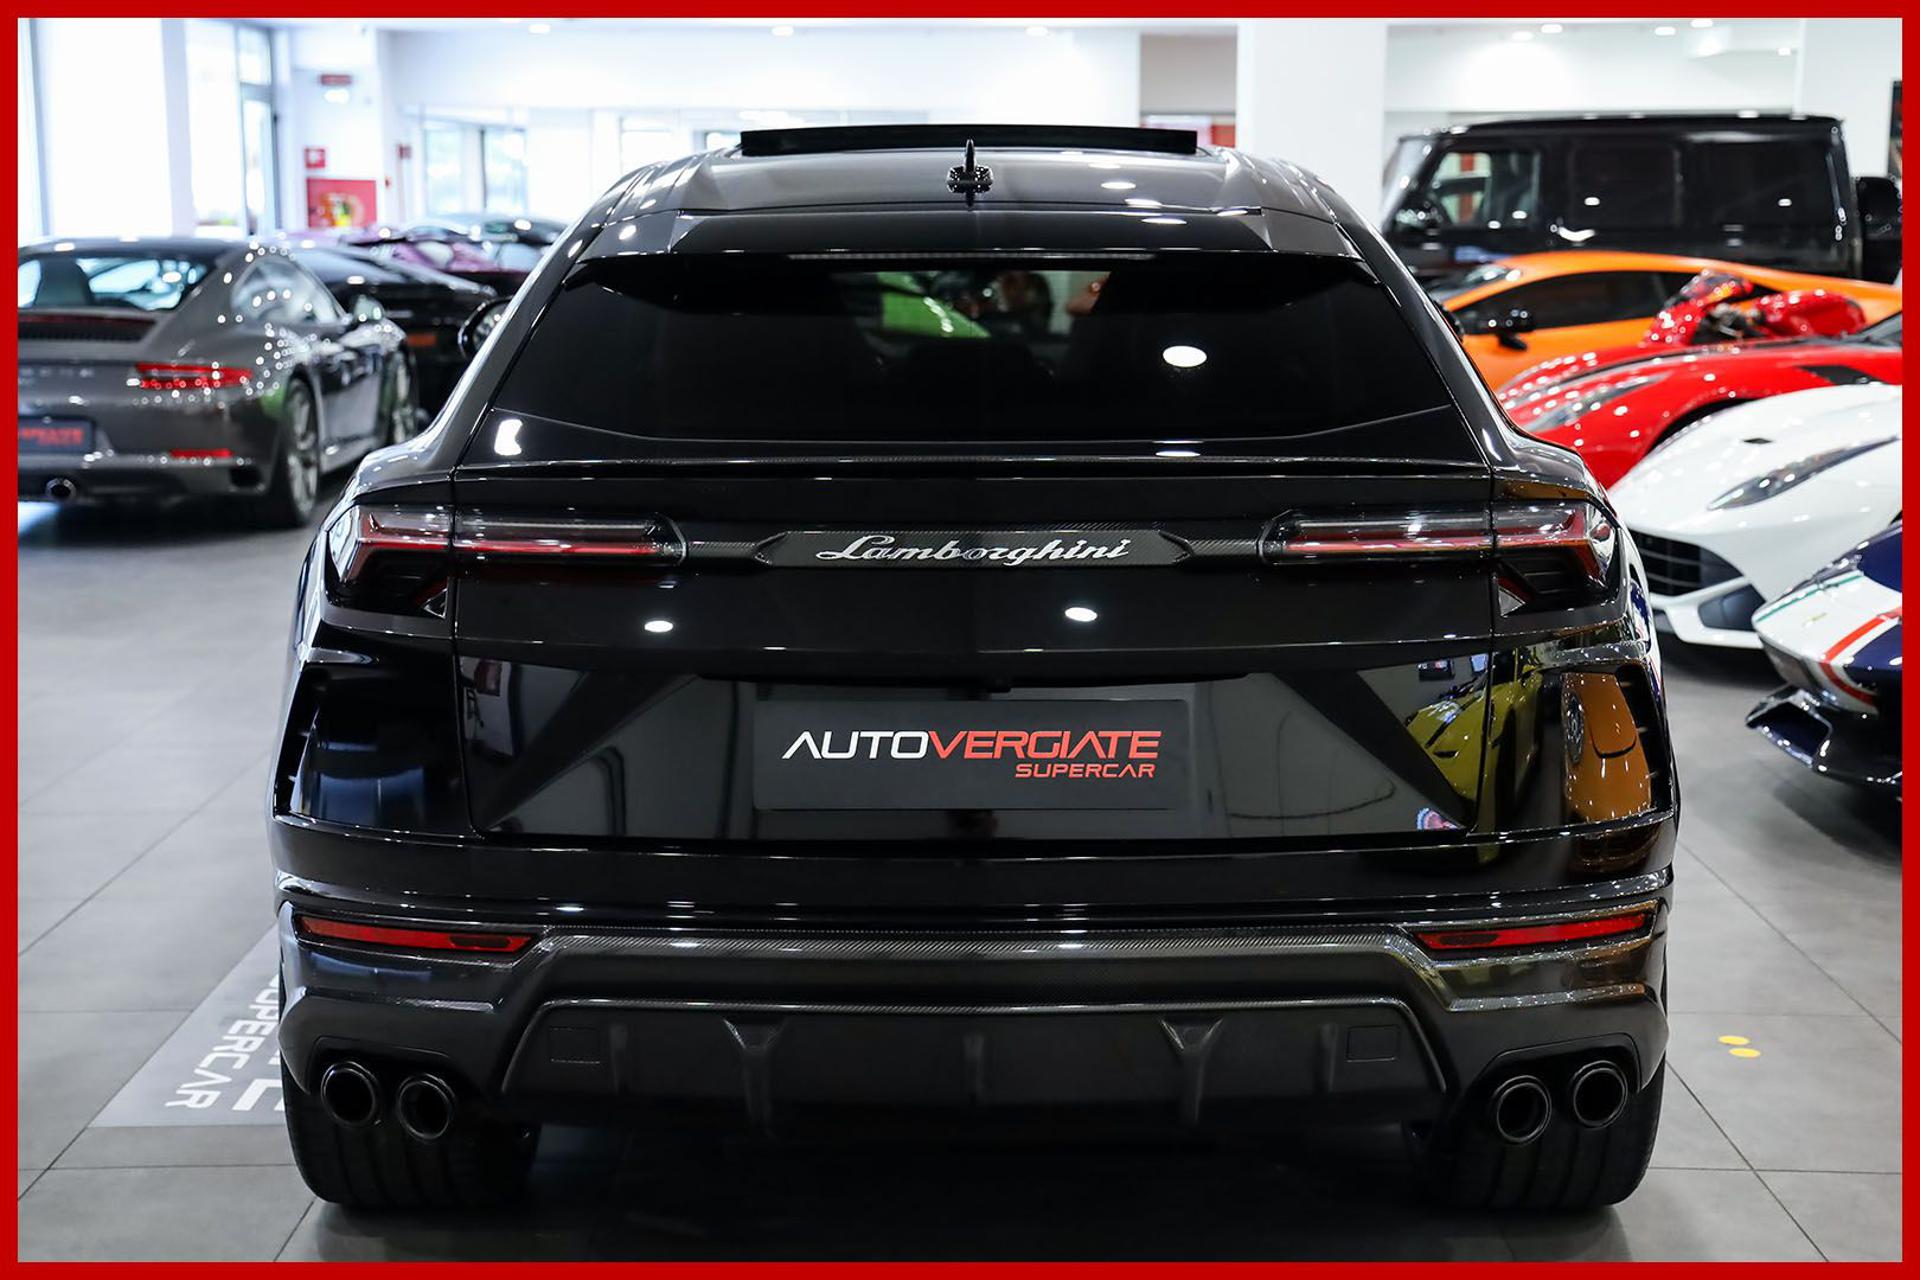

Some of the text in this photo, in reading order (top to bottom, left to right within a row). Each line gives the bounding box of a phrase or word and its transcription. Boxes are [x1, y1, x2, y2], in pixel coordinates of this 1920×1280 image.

[816, 535, 1131, 566] Lamborghini
[782, 730, 1162, 760] AUTOVERGIATE
[1015, 763, 1156, 779] SUPERCAR
[164, 974, 280, 1109] UPERCAR
